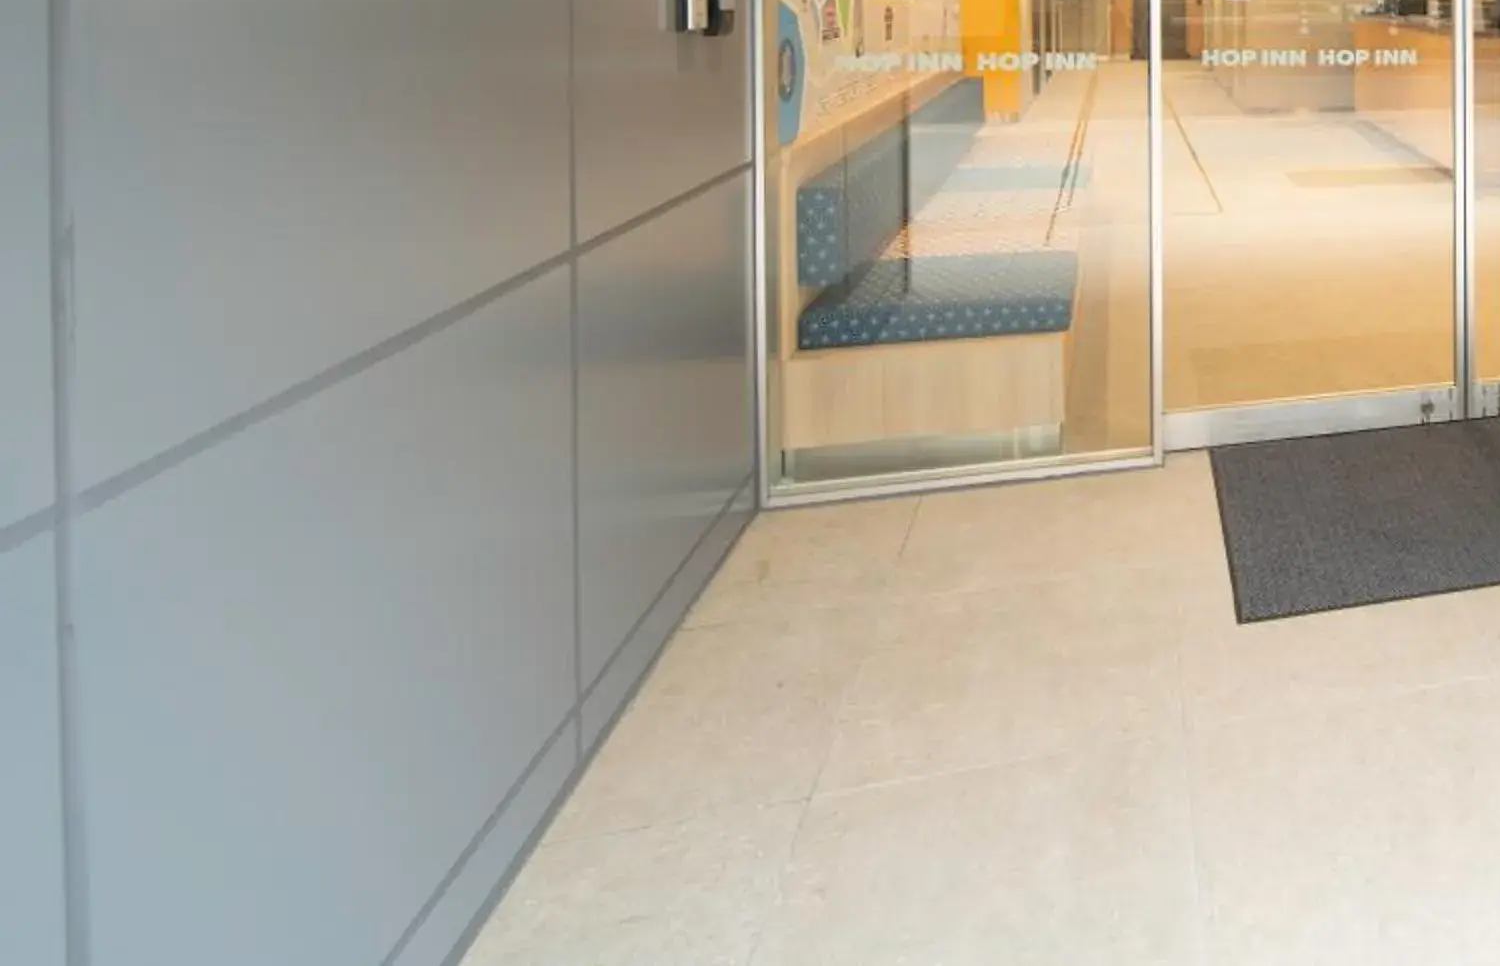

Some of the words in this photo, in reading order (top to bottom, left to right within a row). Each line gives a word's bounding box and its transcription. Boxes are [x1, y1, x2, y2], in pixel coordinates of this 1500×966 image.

[977, 52, 1038, 71] HOP
[1045, 52, 1098, 71] INN
[1202, 49, 1256, 67] HOP
[1261, 50, 1306, 66] INN
[1317, 49, 1369, 66] HOP
[1374, 49, 1417, 66] INN
